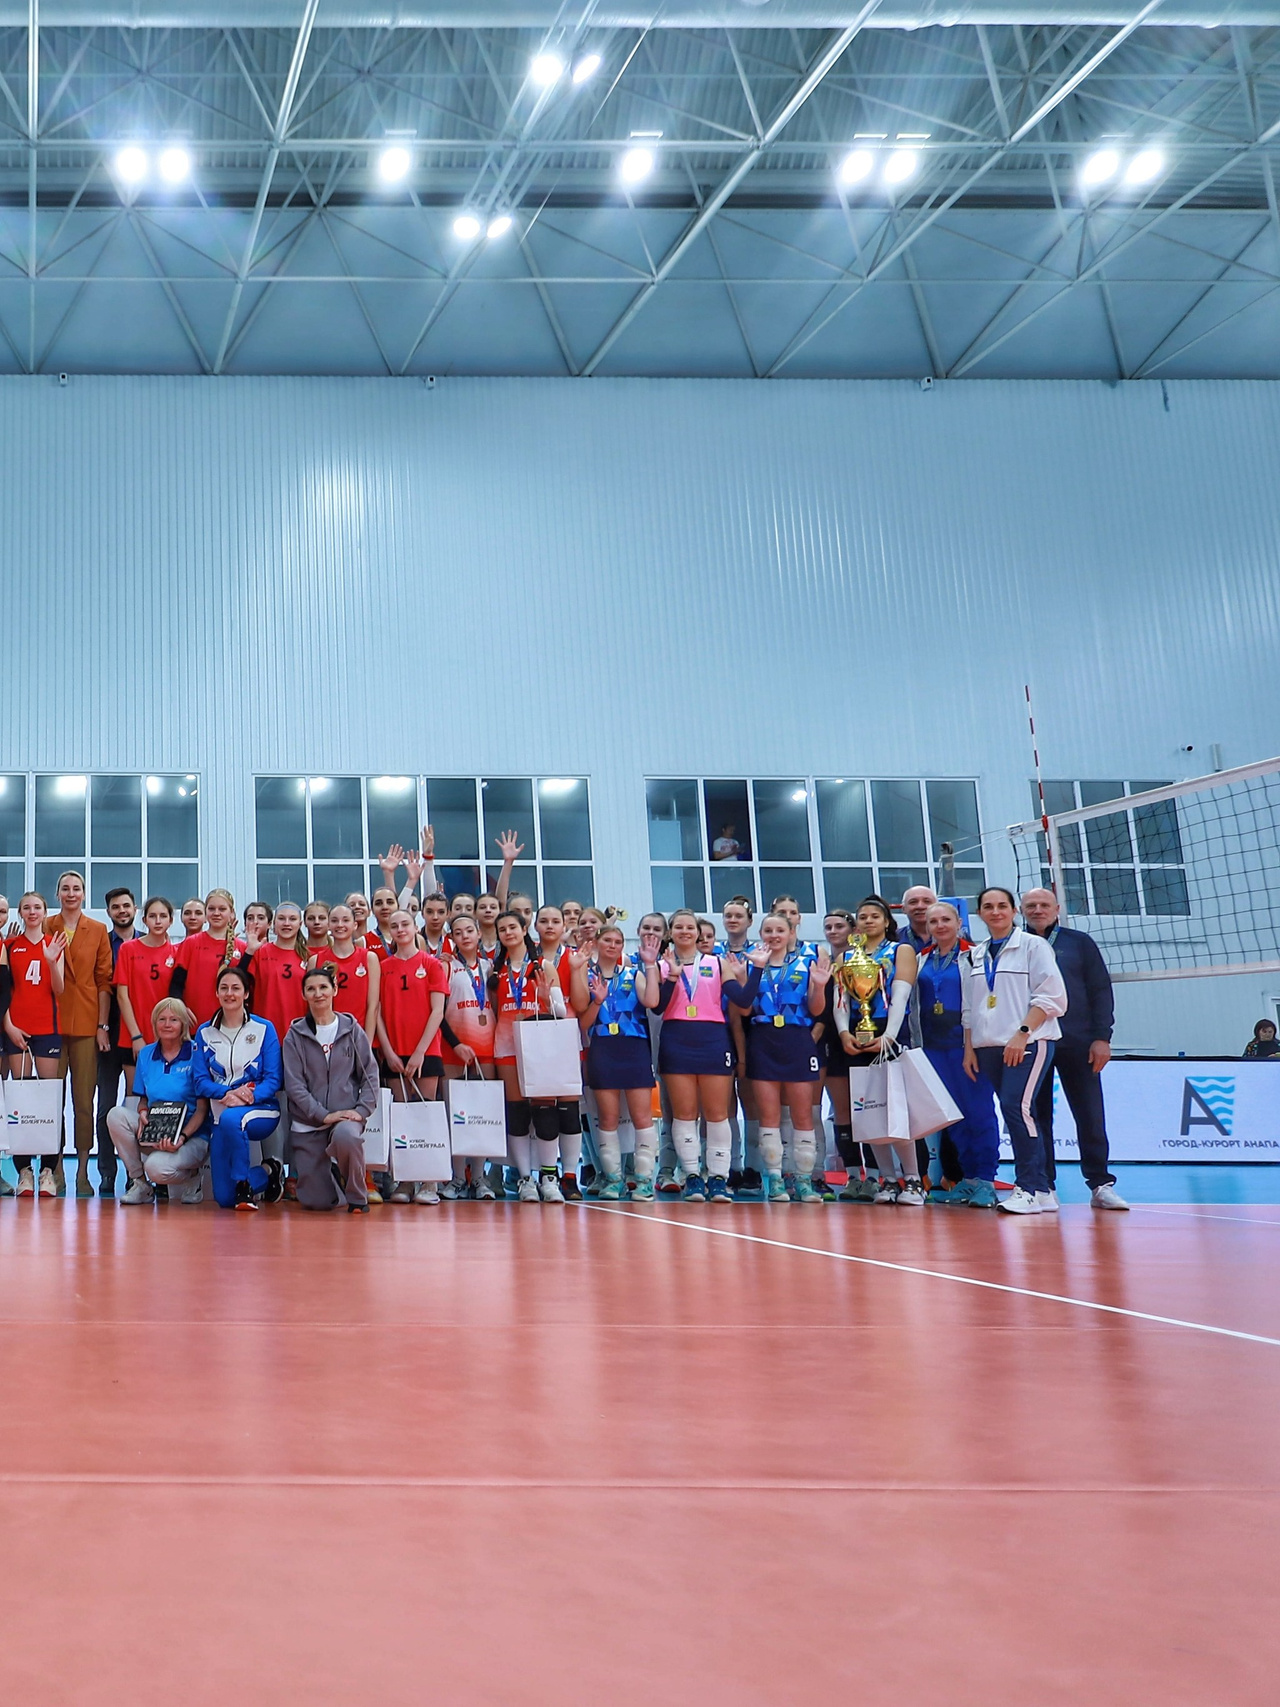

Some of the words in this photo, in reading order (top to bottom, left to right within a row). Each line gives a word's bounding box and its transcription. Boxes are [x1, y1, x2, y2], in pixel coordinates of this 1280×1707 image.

[25, 960, 41, 985] 4
[150, 964, 160, 980] 5
[282, 964, 292, 979] 3
[400, 974, 409, 990] 1
[725, 1052, 732, 1067] 3
[810, 1057, 819, 1072] 9
[1162, 1139, 1241, 1149] ГОРОД-КУРОРТ
[1243, 1139, 1280, 1149] АНАПА
